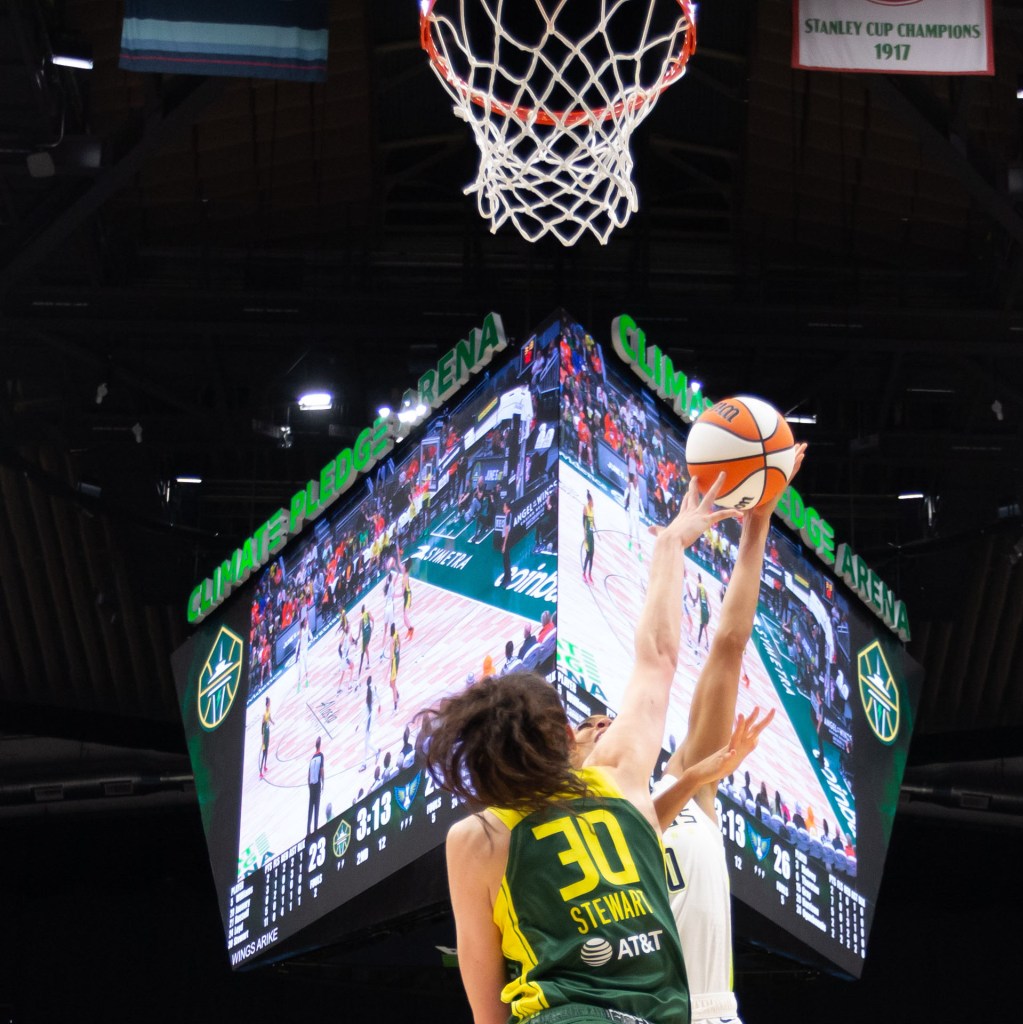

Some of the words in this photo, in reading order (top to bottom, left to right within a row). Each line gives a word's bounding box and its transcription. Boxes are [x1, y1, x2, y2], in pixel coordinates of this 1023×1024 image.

[804, 18, 863, 36] STANLEY
[866, 22, 894, 37] CUP
[897, 23, 981, 39] CHAMPIONS
[874, 43, 911, 61] 1917
[611, 313, 714, 425] CLIMA
[773, 486, 836, 566] EDGE
[835, 543, 912, 642] ARENA
[187, 507, 290, 624] CLIMATE
[289, 412, 397, 535] PLEDGE
[424, 546, 474, 571] SYMETRA
[356, 791, 392, 842] 3:13
[308, 837, 327, 873] 23
[378, 836, 387, 851] 12
[531, 808, 641, 903] 30
[734, 855, 743, 871] 12
[773, 844, 791, 880] 26
[570, 888, 655, 936] STEWART
[231, 941, 256, 967] WINGS
[256, 927, 279, 951] ARIKE
[617, 929, 663, 960] AT&T
